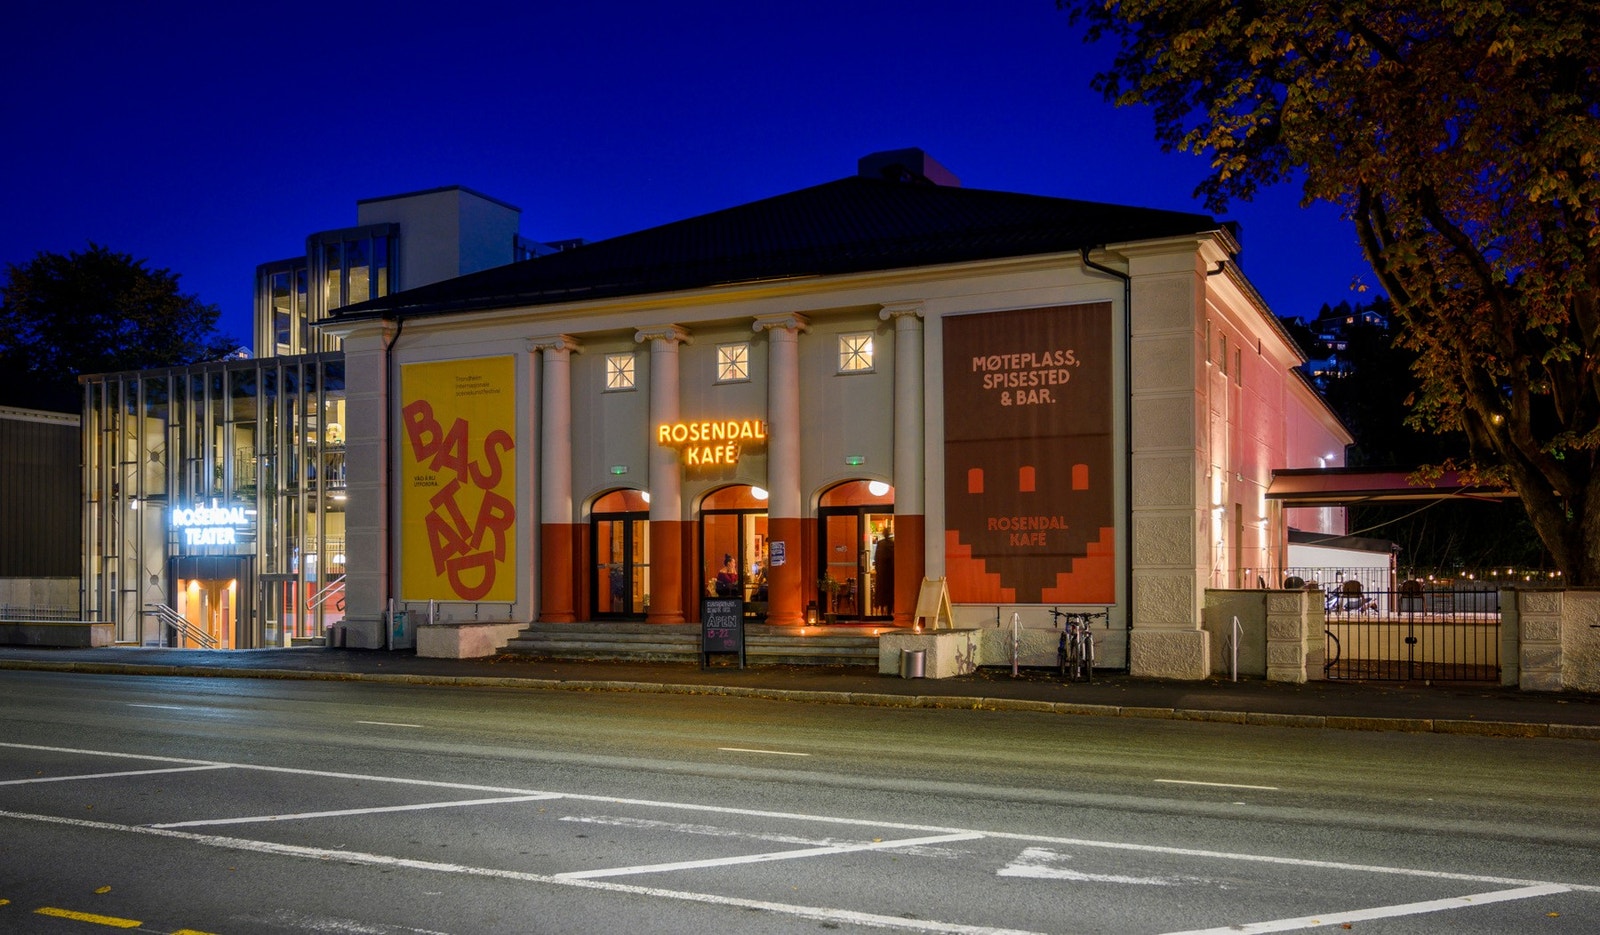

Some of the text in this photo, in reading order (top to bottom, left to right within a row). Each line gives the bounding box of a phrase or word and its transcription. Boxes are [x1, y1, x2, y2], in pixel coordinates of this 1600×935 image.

[972, 349, 1081, 372] MØTEPLASS,
[983, 368, 1071, 390] SPISESTED
[1000, 388, 1057, 407] & BAR.
[659, 420, 766, 443] ROSENDAL
[687, 440, 736, 465] KAFÉ
[172, 507, 249, 526] ROSENDAL
[987, 515, 1069, 531] ROSENDAL
[184, 527, 236, 546] TEATER
[1009, 530, 1047, 546] KAFÉ
